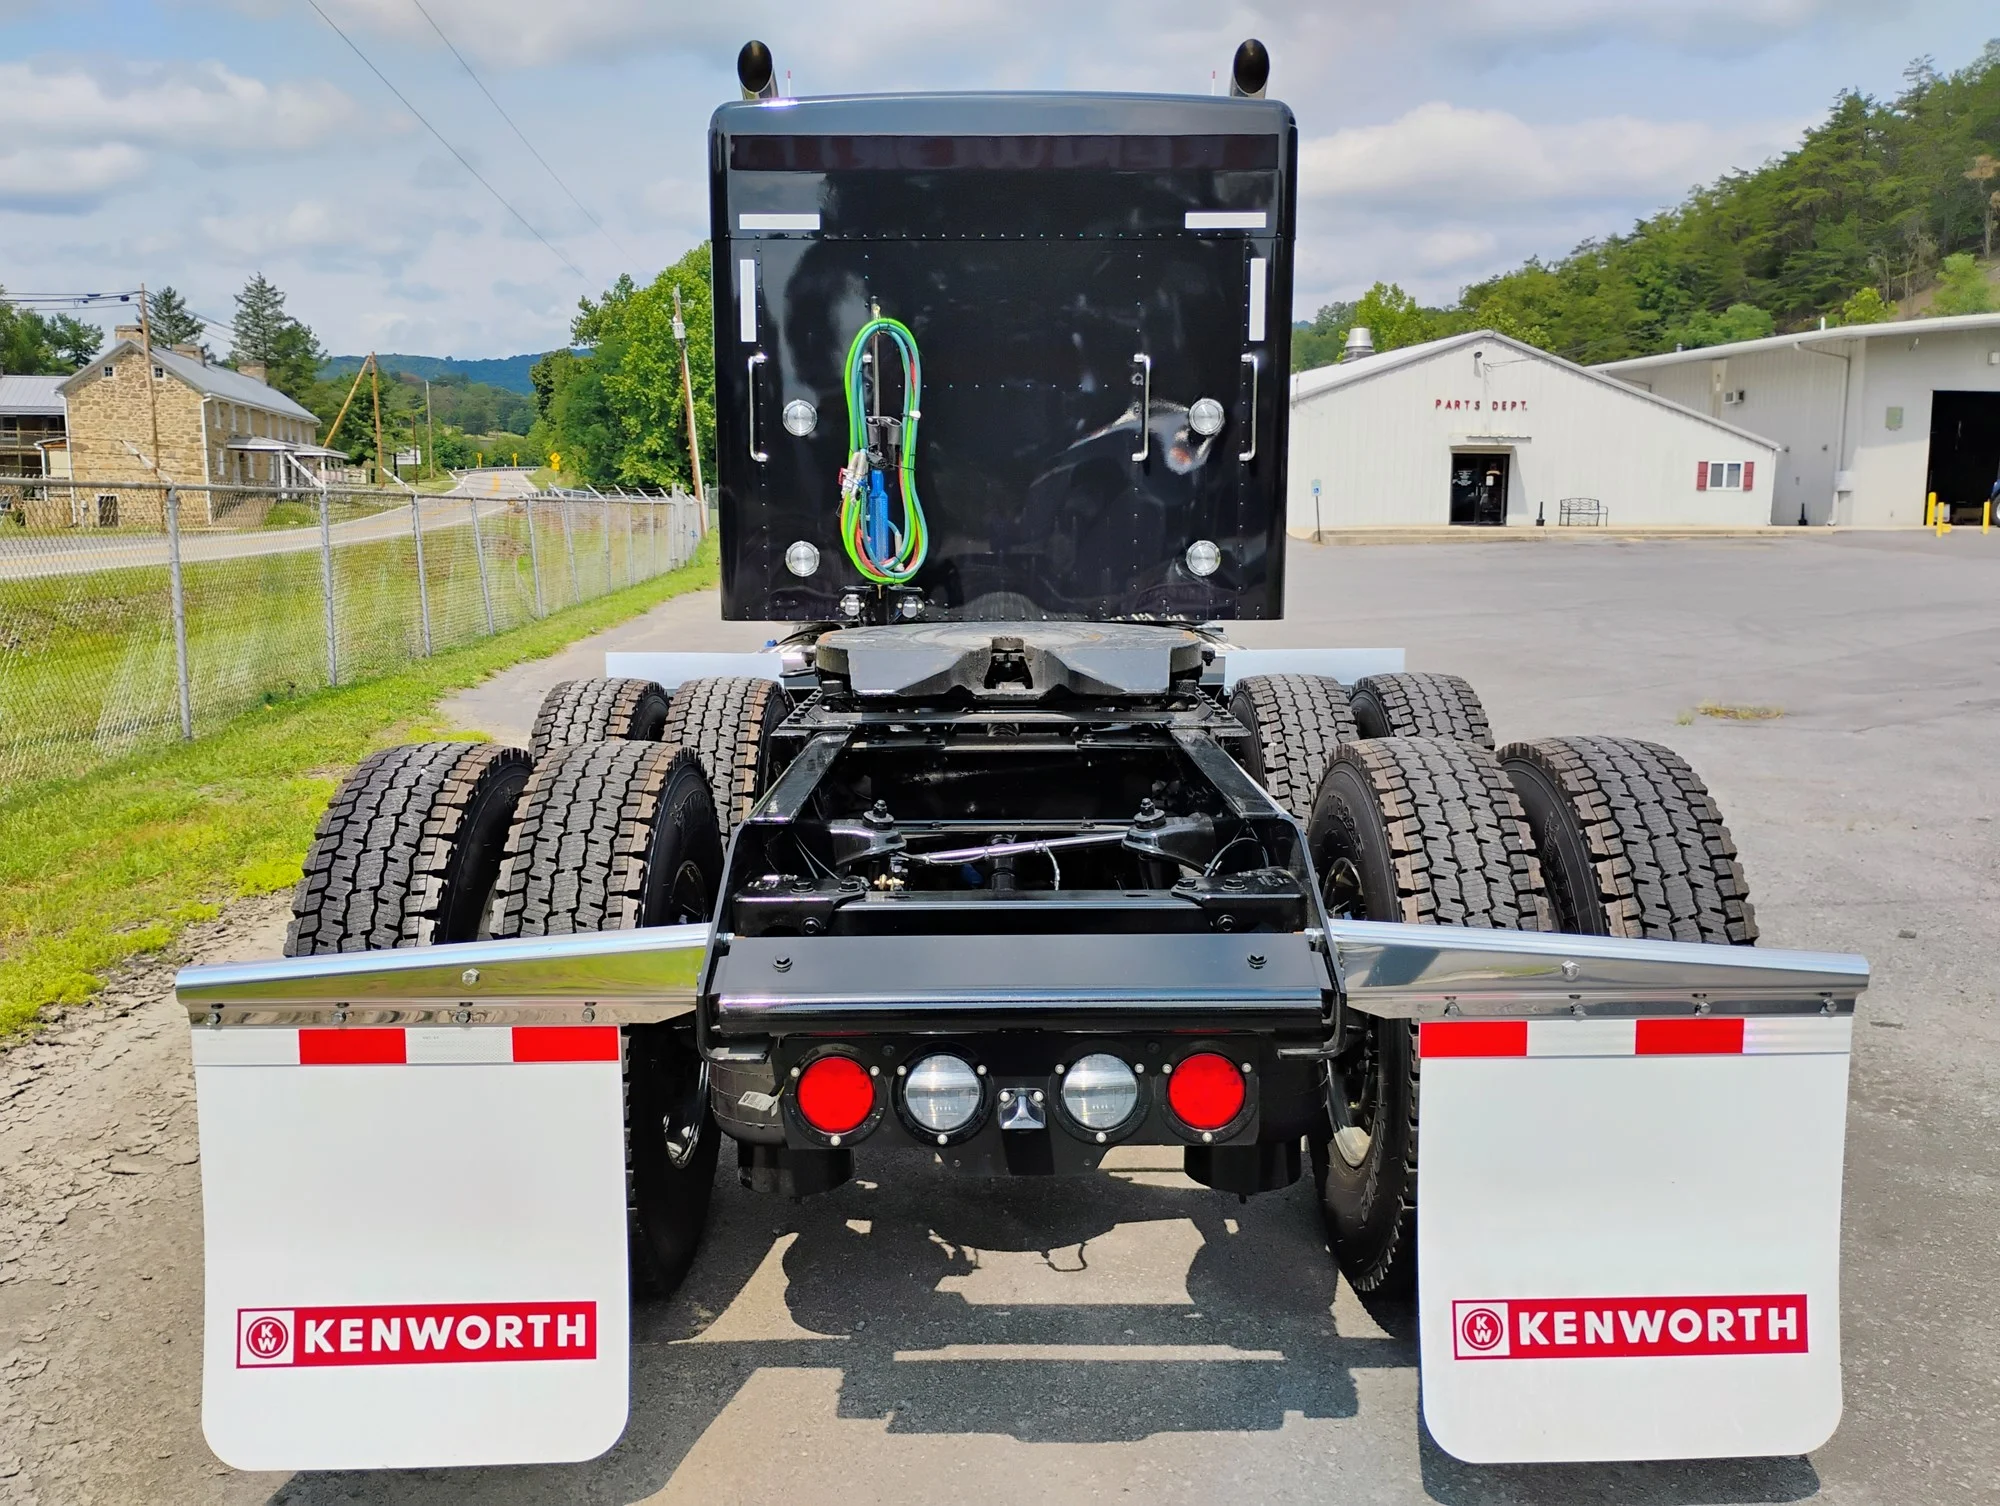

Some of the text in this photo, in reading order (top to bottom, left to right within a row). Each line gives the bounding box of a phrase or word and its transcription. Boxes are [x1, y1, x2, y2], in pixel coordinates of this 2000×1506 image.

[1435, 399, 1527, 411] PARTS DEPT.
[304, 1313, 586, 1354] KENWORTH
[1518, 1307, 1797, 1346] KENWORTH
